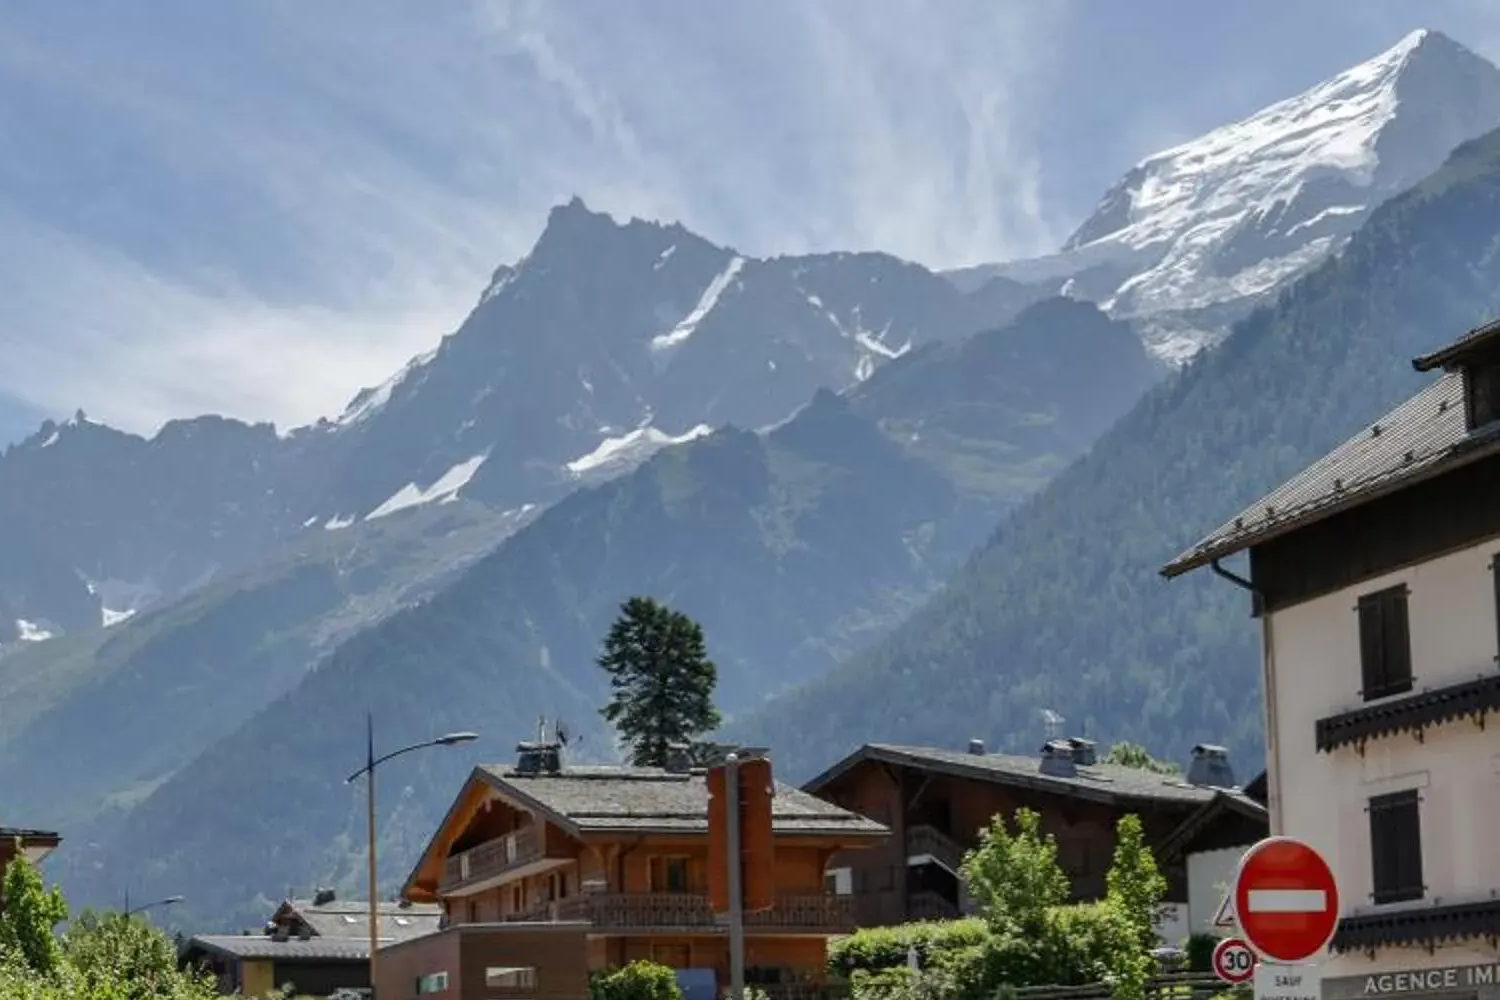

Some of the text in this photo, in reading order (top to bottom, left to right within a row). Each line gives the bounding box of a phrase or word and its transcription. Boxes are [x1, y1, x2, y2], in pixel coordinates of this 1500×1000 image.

[1225, 951, 1250, 970] 30
[1275, 975, 1302, 986] SAUF
[1364, 965, 1500, 994] AGENCE IM
